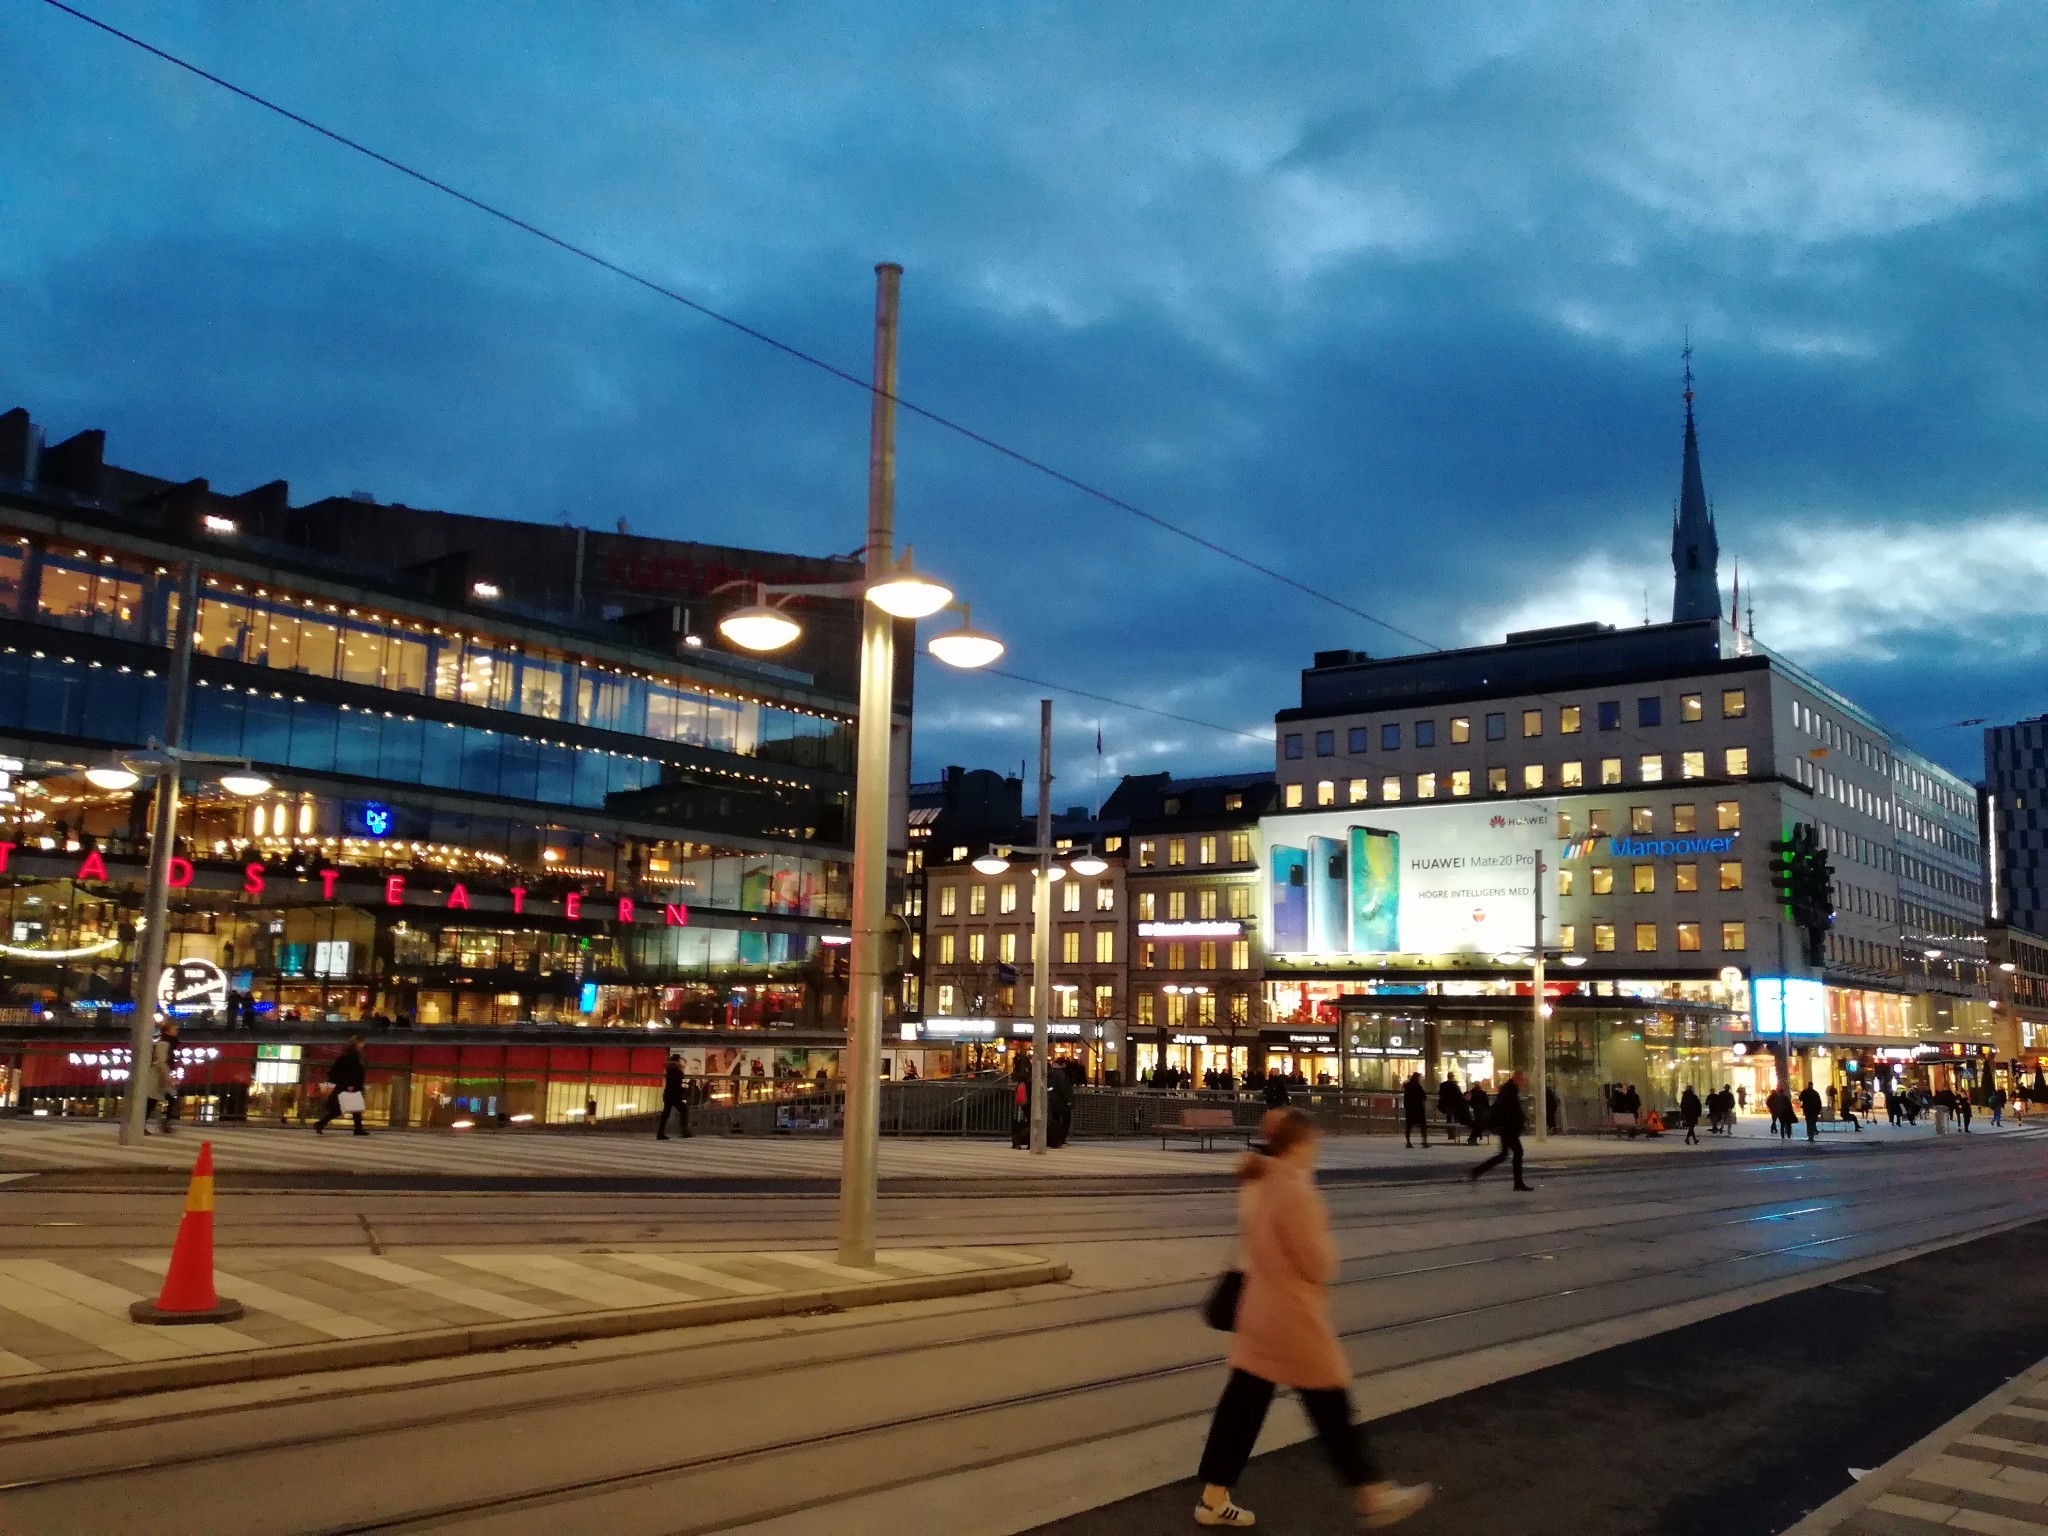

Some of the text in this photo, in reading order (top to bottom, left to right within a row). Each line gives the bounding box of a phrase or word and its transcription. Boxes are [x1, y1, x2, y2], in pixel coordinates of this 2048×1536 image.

[1508, 816, 1548, 827] HUAWEI
[1609, 836, 1735, 858] Manpower
[1411, 854, 1534, 870] HUAWEI Mate20 Pro
[1418, 888, 1449, 899] HÖGRE
[1451, 888, 1507, 898] INTELLIGENS
[1509, 887, 1530, 897] MED
